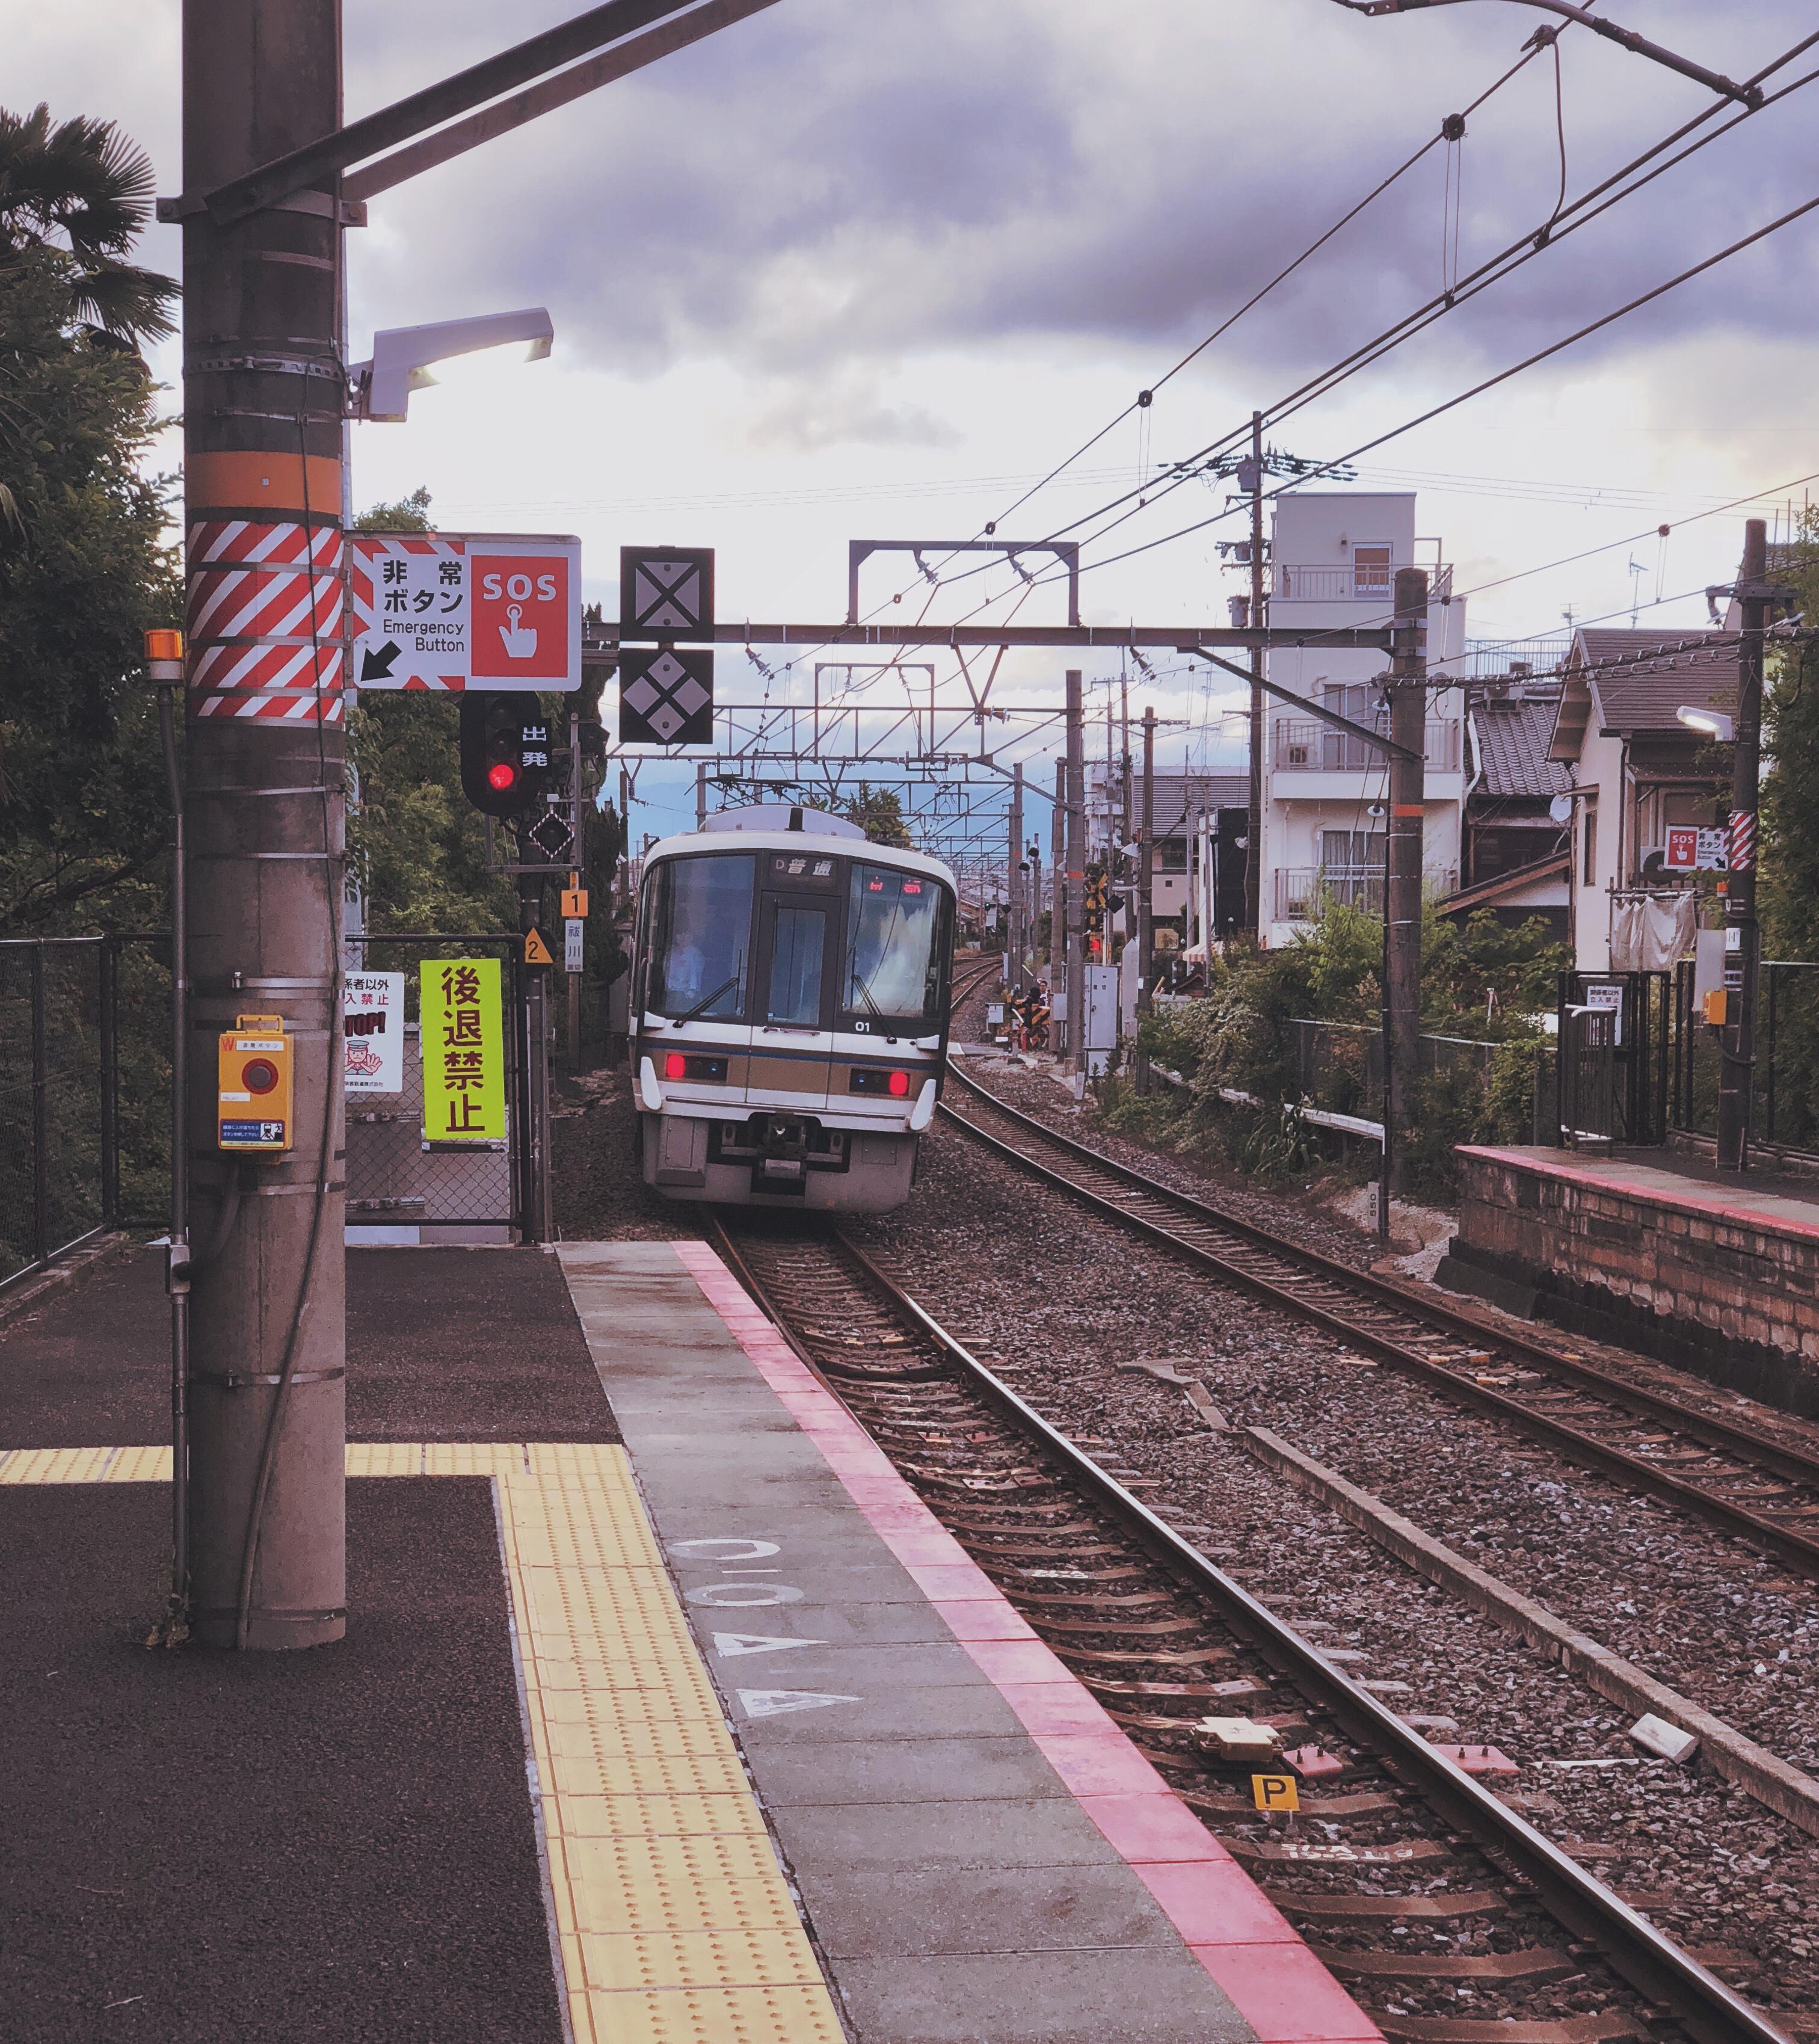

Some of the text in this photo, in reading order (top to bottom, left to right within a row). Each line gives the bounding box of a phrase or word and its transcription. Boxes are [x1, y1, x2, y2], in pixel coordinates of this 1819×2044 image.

[383, 559, 463, 586] 非常
[482, 573, 557, 600] SOS
[384, 589, 463, 614] ボタン
[383, 619, 464, 636] Emergency
[415, 636, 465, 653] Button
[522, 725, 548, 768] 出発
[1672, 834, 1694, 844] SOS
[775, 858, 833, 876] D 普通
[571, 894, 578, 913] 1
[528, 941, 538, 960] 2
[855, 1021, 870, 1032] 01
[441, 965, 485, 1132] 後退禁止
[1262, 1778, 1287, 1805] P
